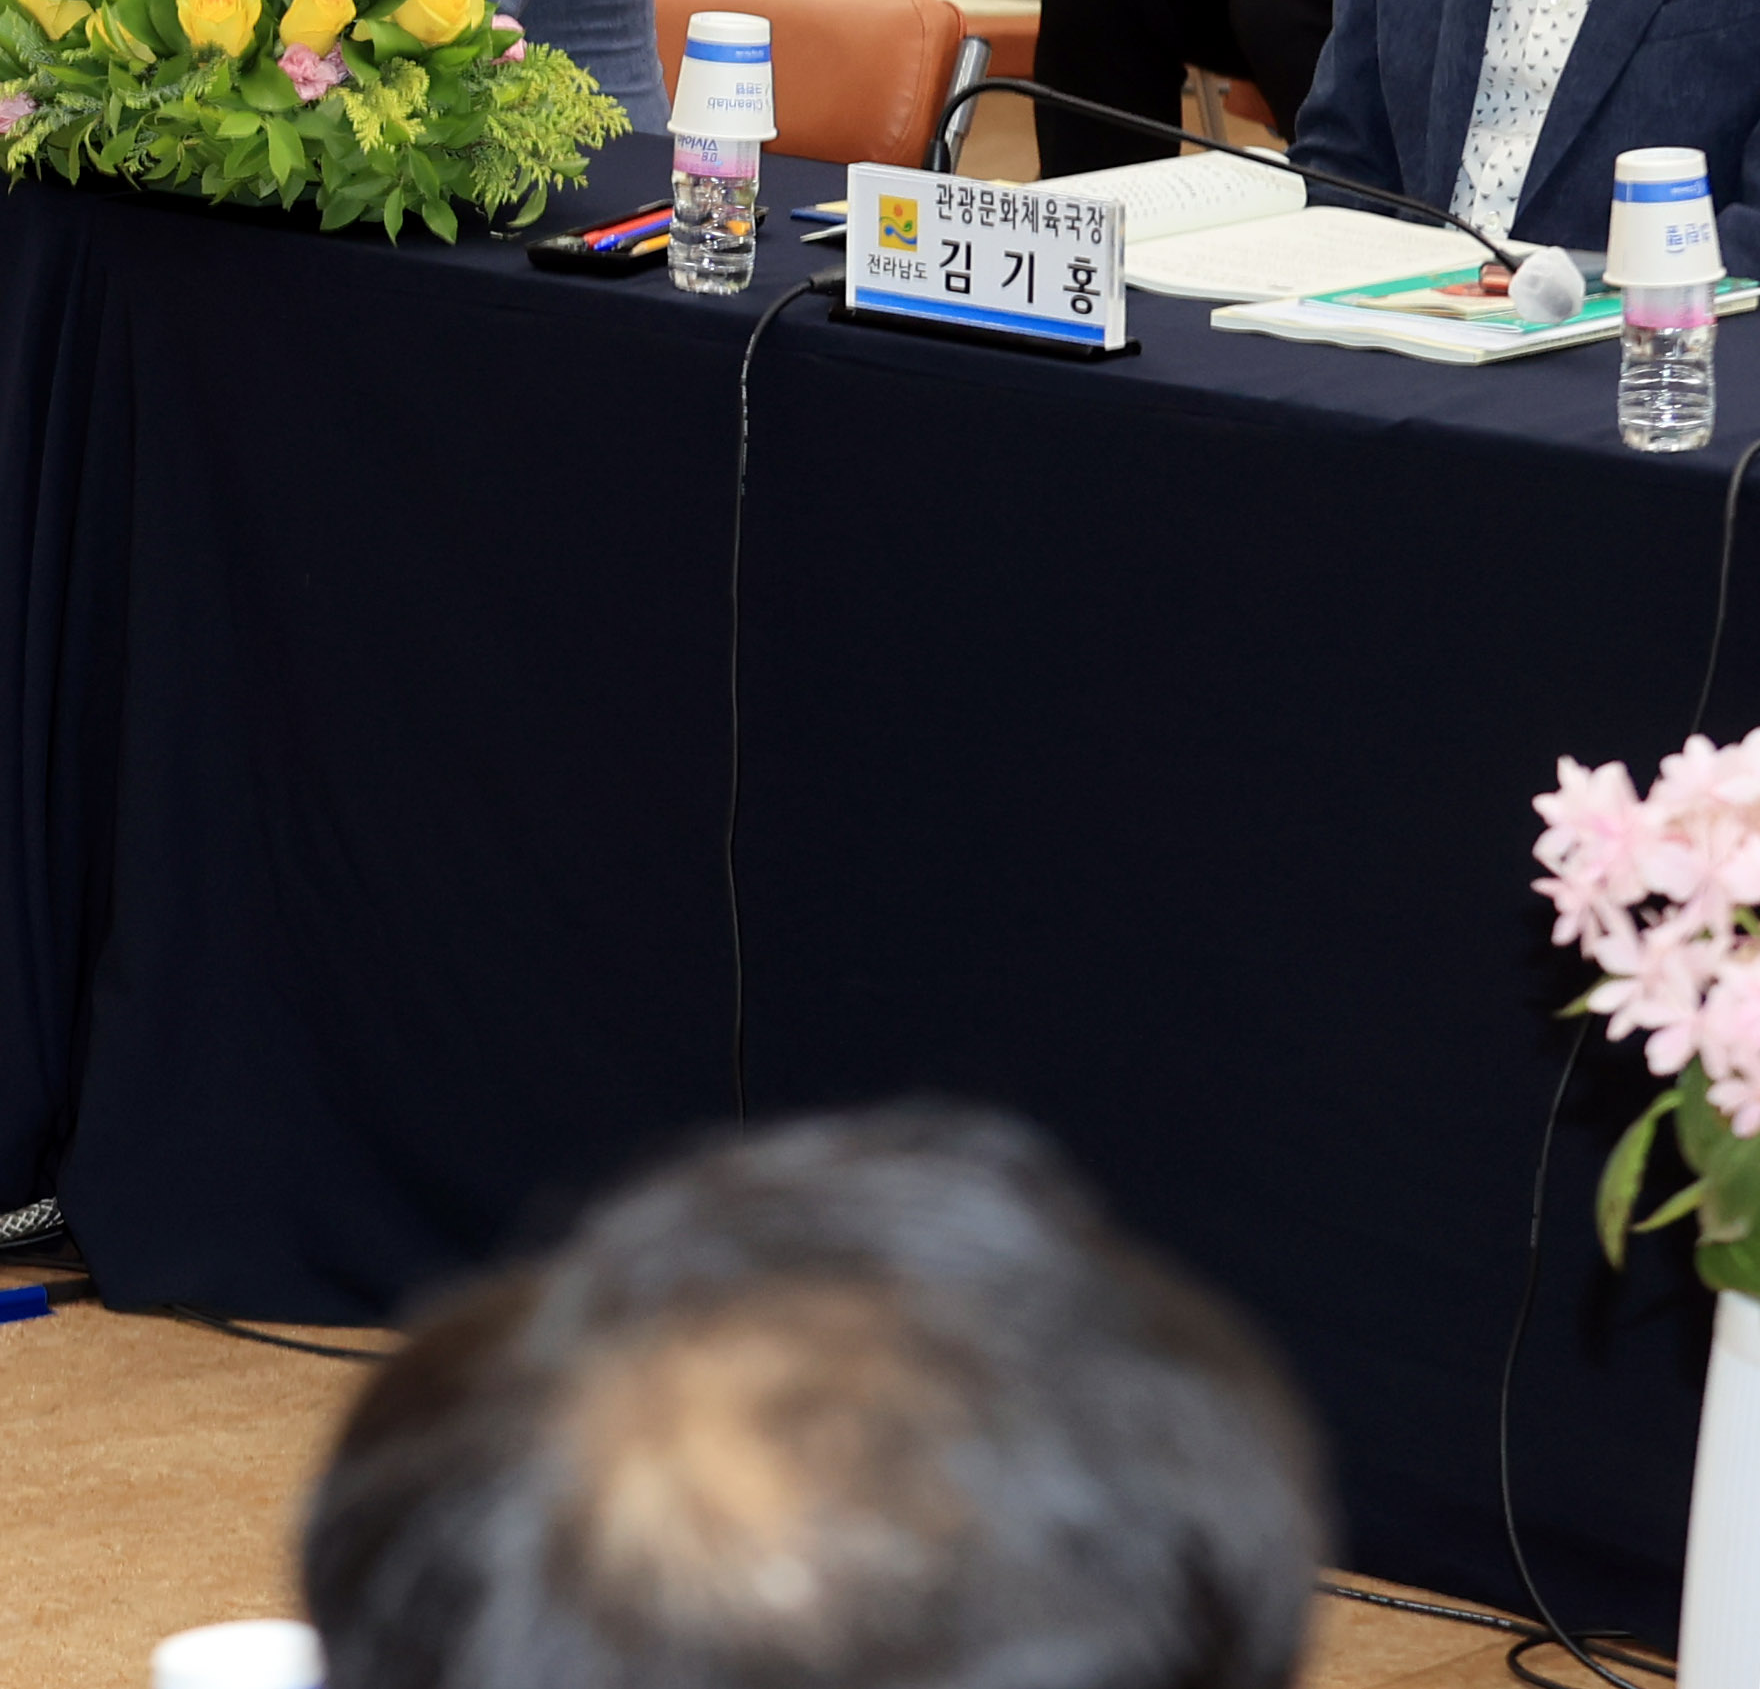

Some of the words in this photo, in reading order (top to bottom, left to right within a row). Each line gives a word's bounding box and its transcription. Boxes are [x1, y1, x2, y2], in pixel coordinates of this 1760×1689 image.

[707, 96, 764, 112] Cleanlab
[935, 182, 1106, 245] 관광문화체육국장
[866, 253, 929, 281] 전라남도
